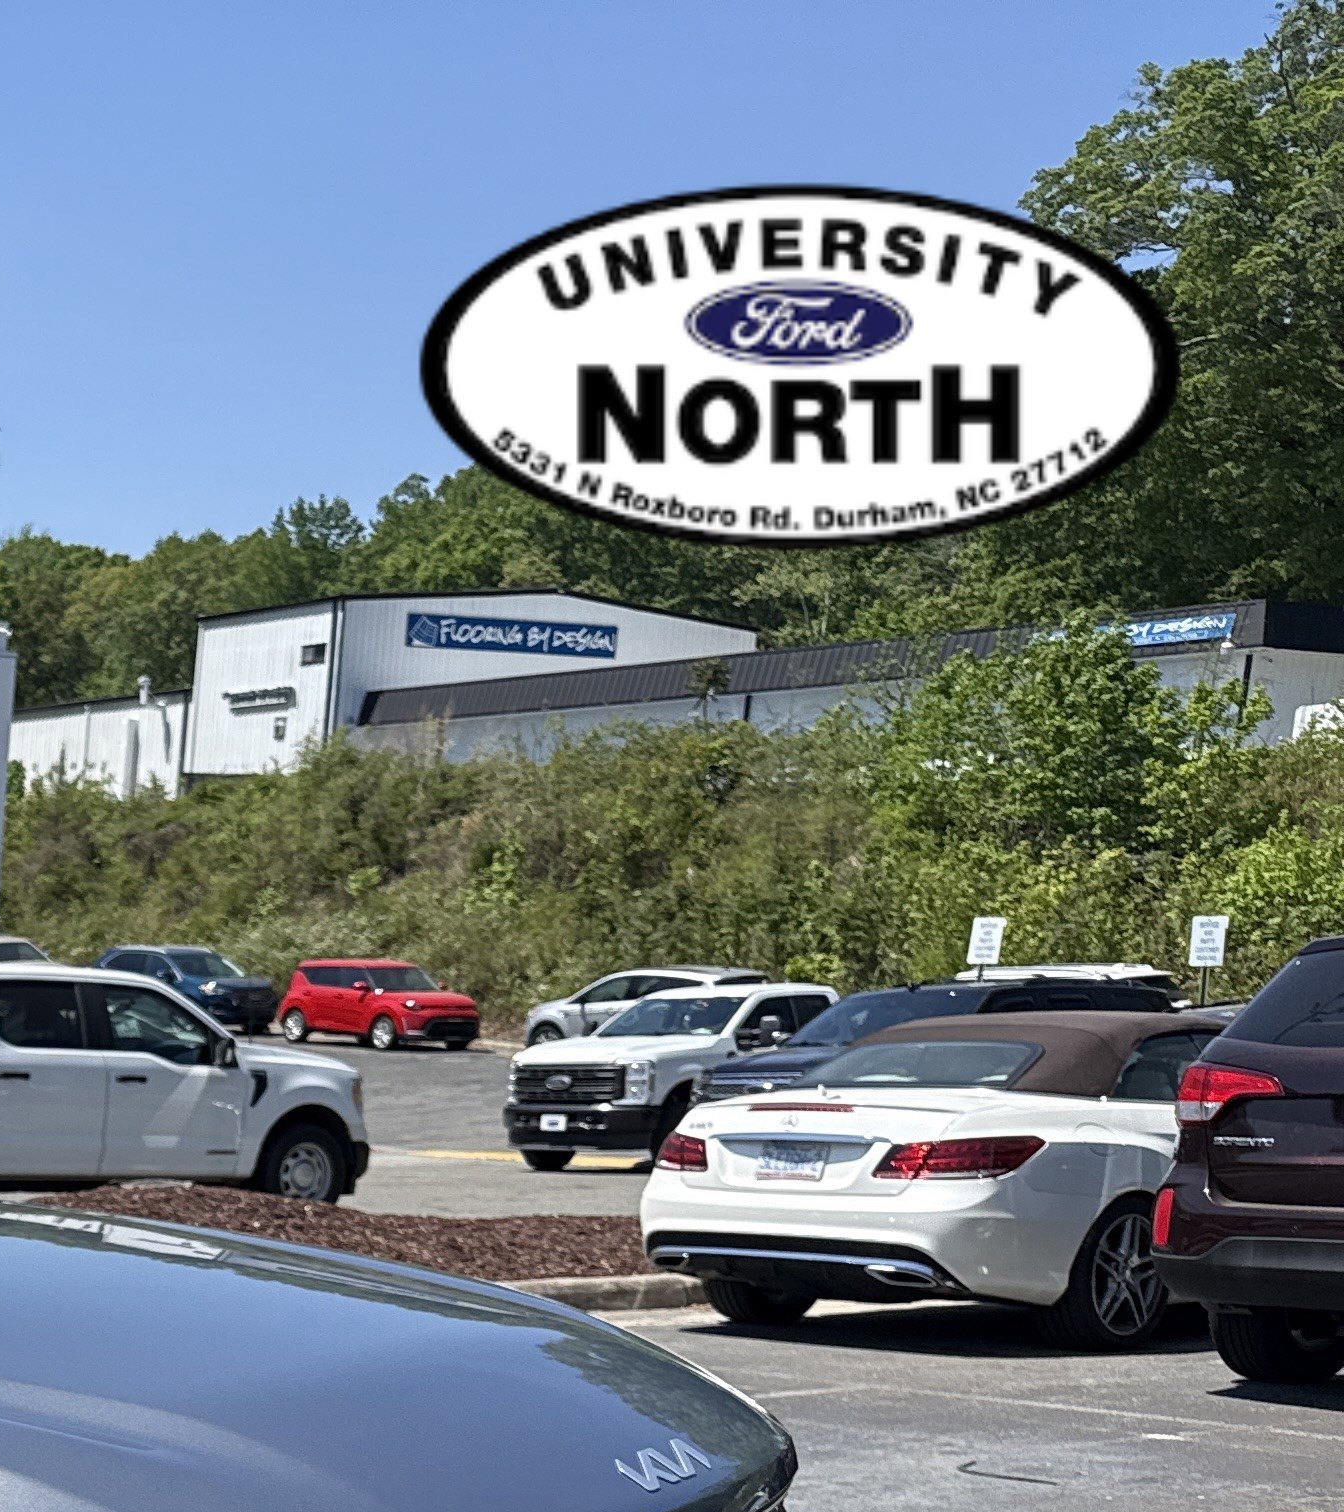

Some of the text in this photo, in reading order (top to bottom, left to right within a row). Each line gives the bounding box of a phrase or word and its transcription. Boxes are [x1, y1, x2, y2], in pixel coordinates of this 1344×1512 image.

[439, 618, 616, 652] FLOORING BY DESIGN
